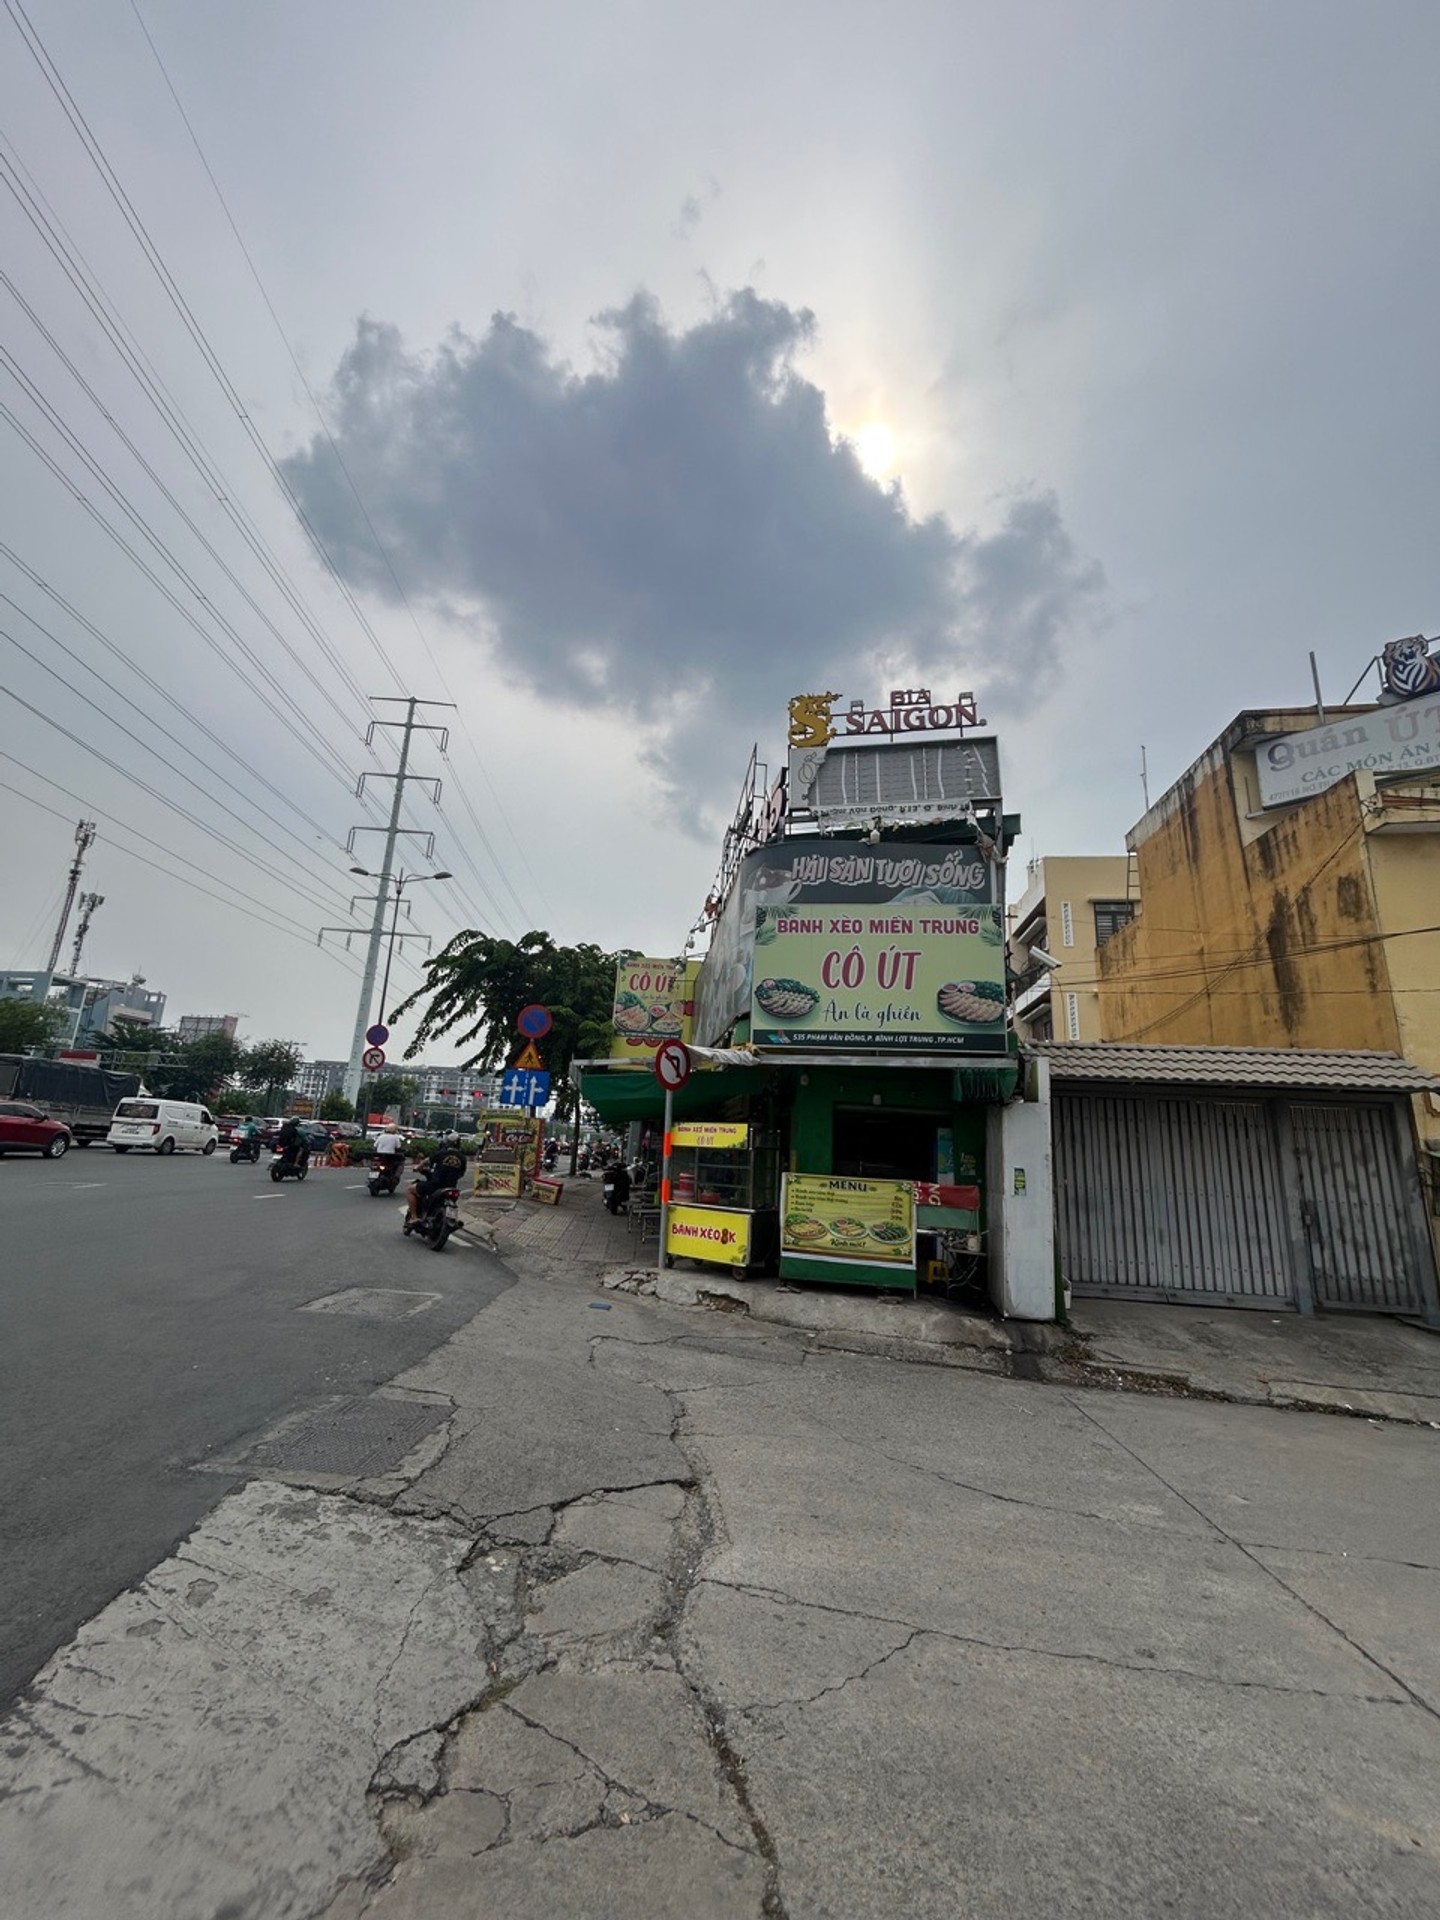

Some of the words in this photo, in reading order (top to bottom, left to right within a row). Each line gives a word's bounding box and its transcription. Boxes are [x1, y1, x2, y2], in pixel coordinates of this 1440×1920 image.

[892, 689, 930, 704] BIA
[846, 702, 977, 734] SAIGON
[1302, 761, 1341, 784] CÁC
[1346, 751, 1393, 772] MÓN
[1400, 742, 1430, 760] ĂN
[875, 857, 925, 887] TƯƠI
[924, 849, 986, 890] SỐNG
[777, 916, 823, 933] BÁNH
[829, 914, 863, 934] XÈO
[869, 914, 913, 934] MIỀN
[919, 919, 979, 934] TRUNG
[821, 945, 865, 989] CÔ
[877, 945, 922, 990] ÚT
[829, 1180, 867, 1192] MENU
